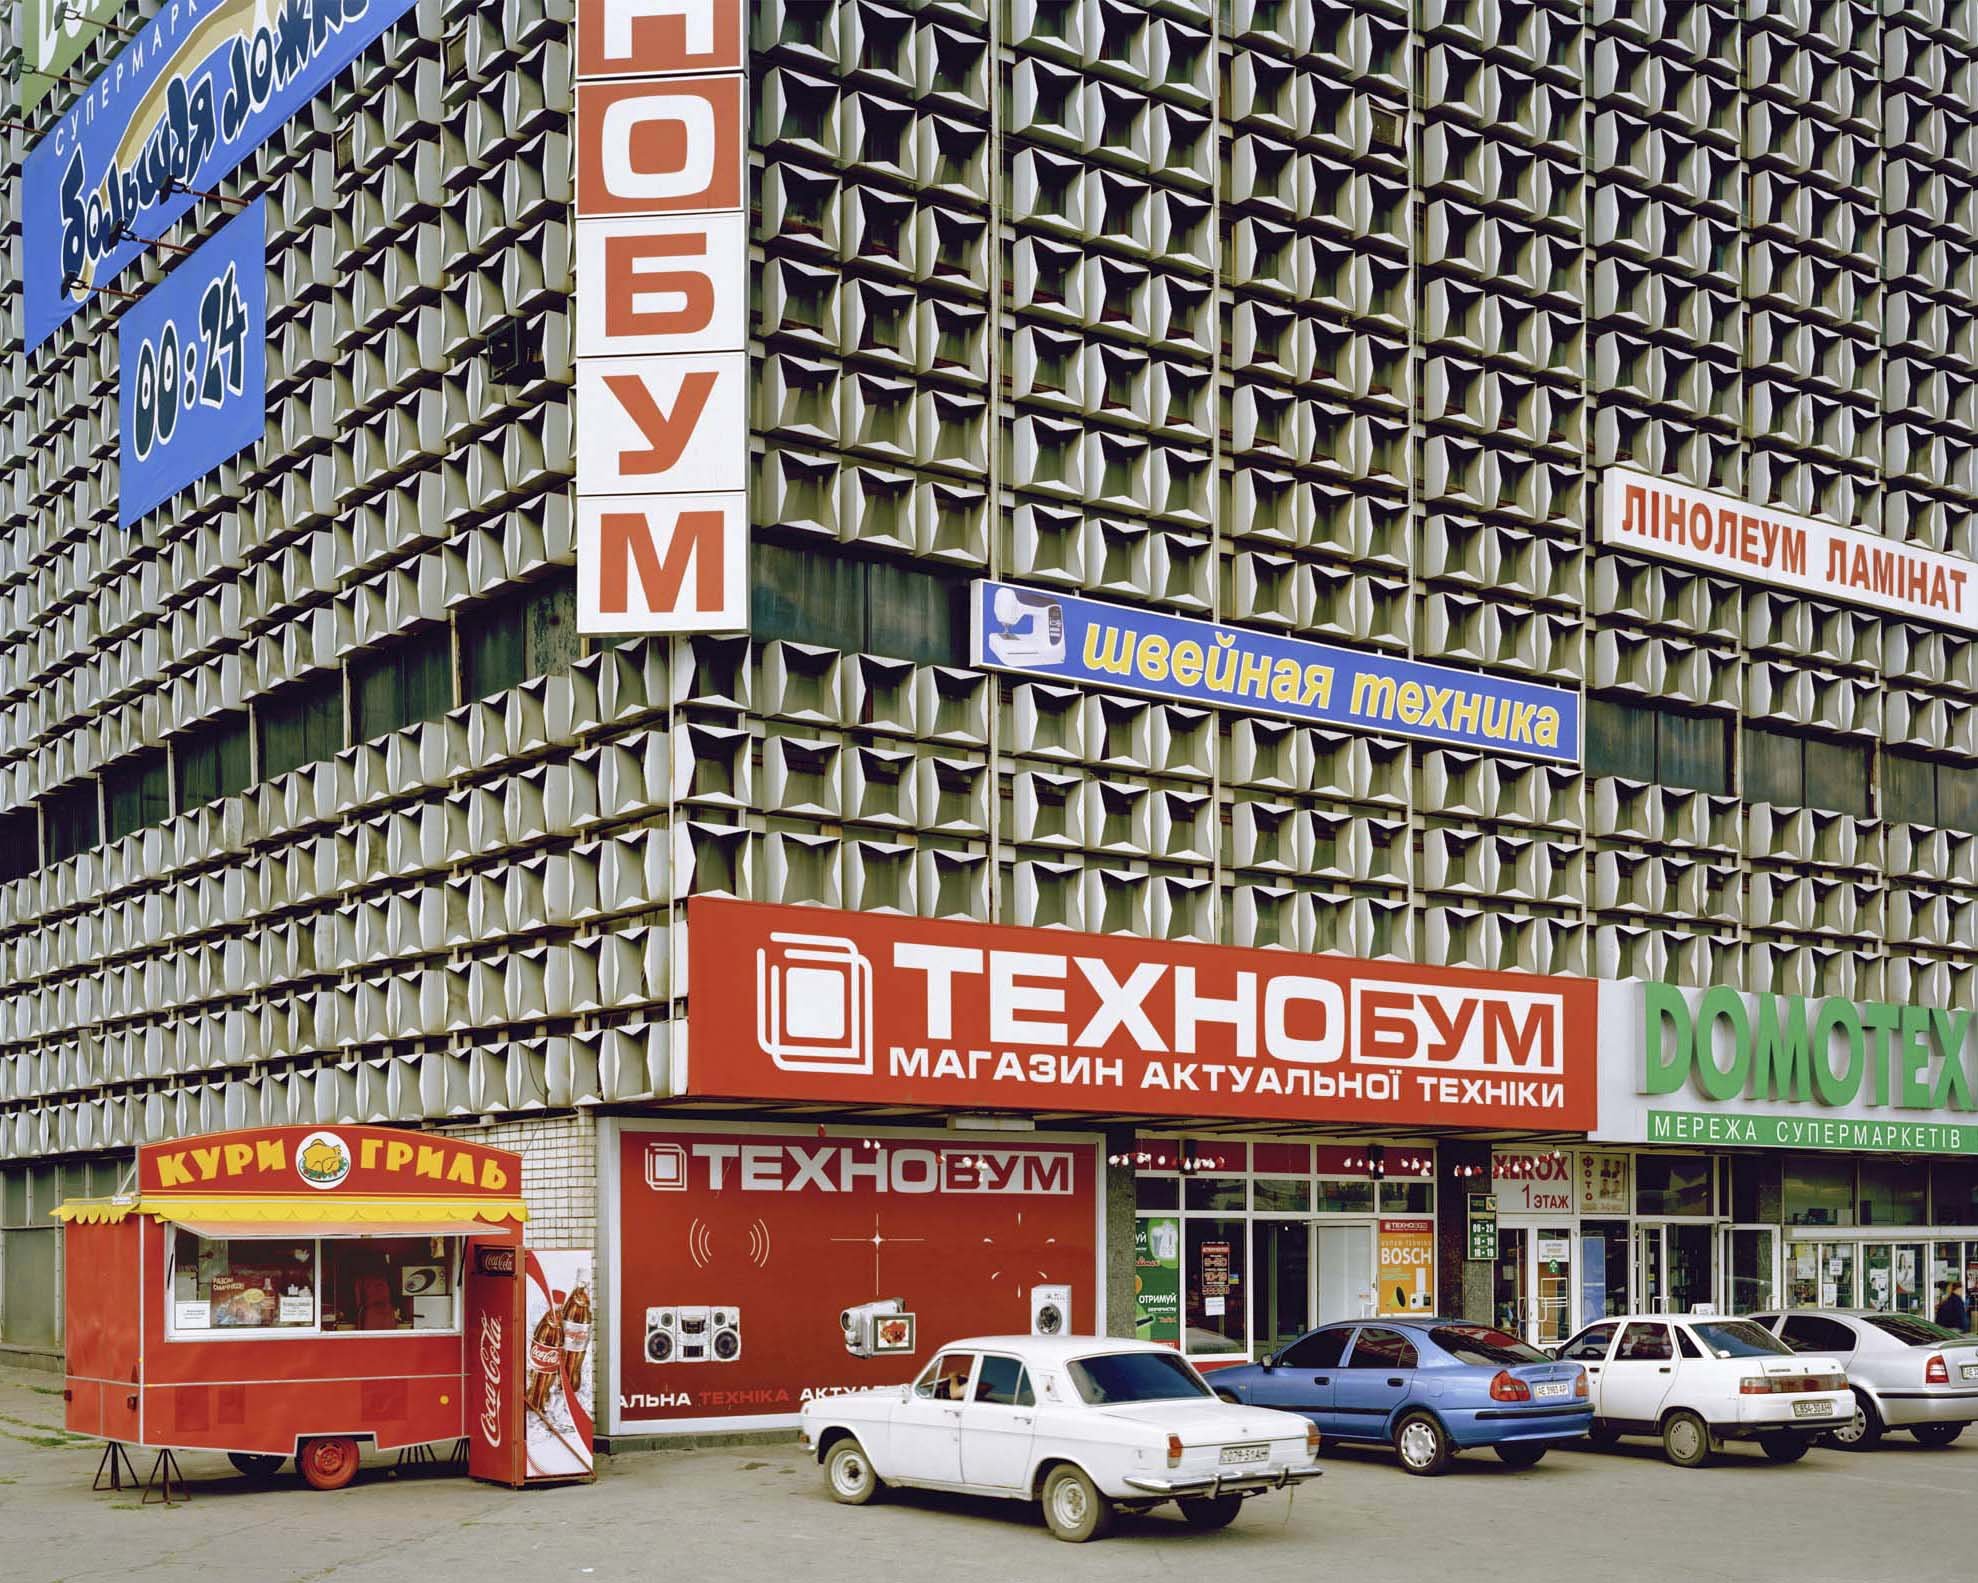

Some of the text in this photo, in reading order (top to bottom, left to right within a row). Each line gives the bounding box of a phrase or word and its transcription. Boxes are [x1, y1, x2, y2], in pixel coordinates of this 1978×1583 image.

[134, 261, 248, 462] 00:24
[1621, 484, 1968, 614] ЛІНОЛЕУМ ЛАМІНАТ
[1082, 622, 1560, 749] швейная техника
[893, 942, 1562, 1072] ТЕХНОБУМ
[1640, 982, 1978, 1112] DOMOTEX
[889, 1047, 1565, 1108] МАГАЗИН АКТУАЛЬНОЇ ТЕХНІКИ
[1654, 1115, 1961, 1149] МЕРЕЖА СУПЕРМАРКЕТІВ
[156, 1138, 508, 1191] КУРИ ГРИЛЬ
[1492, 1155, 1569, 1181] XEROX
[1582, 1155, 1594, 1201] ФОТО
[1521, 1183, 1530, 1209] 1
[1533, 1194, 1569, 1209] ЭТАЖ
[1381, 1247, 1432, 1265] BOSCH
[1138, 1292, 1177, 1305] ОТРИМУЙ
[480, 1309, 502, 1448] Coca-Cola
[700, 1388, 790, 1406] ТЕХНІКА
